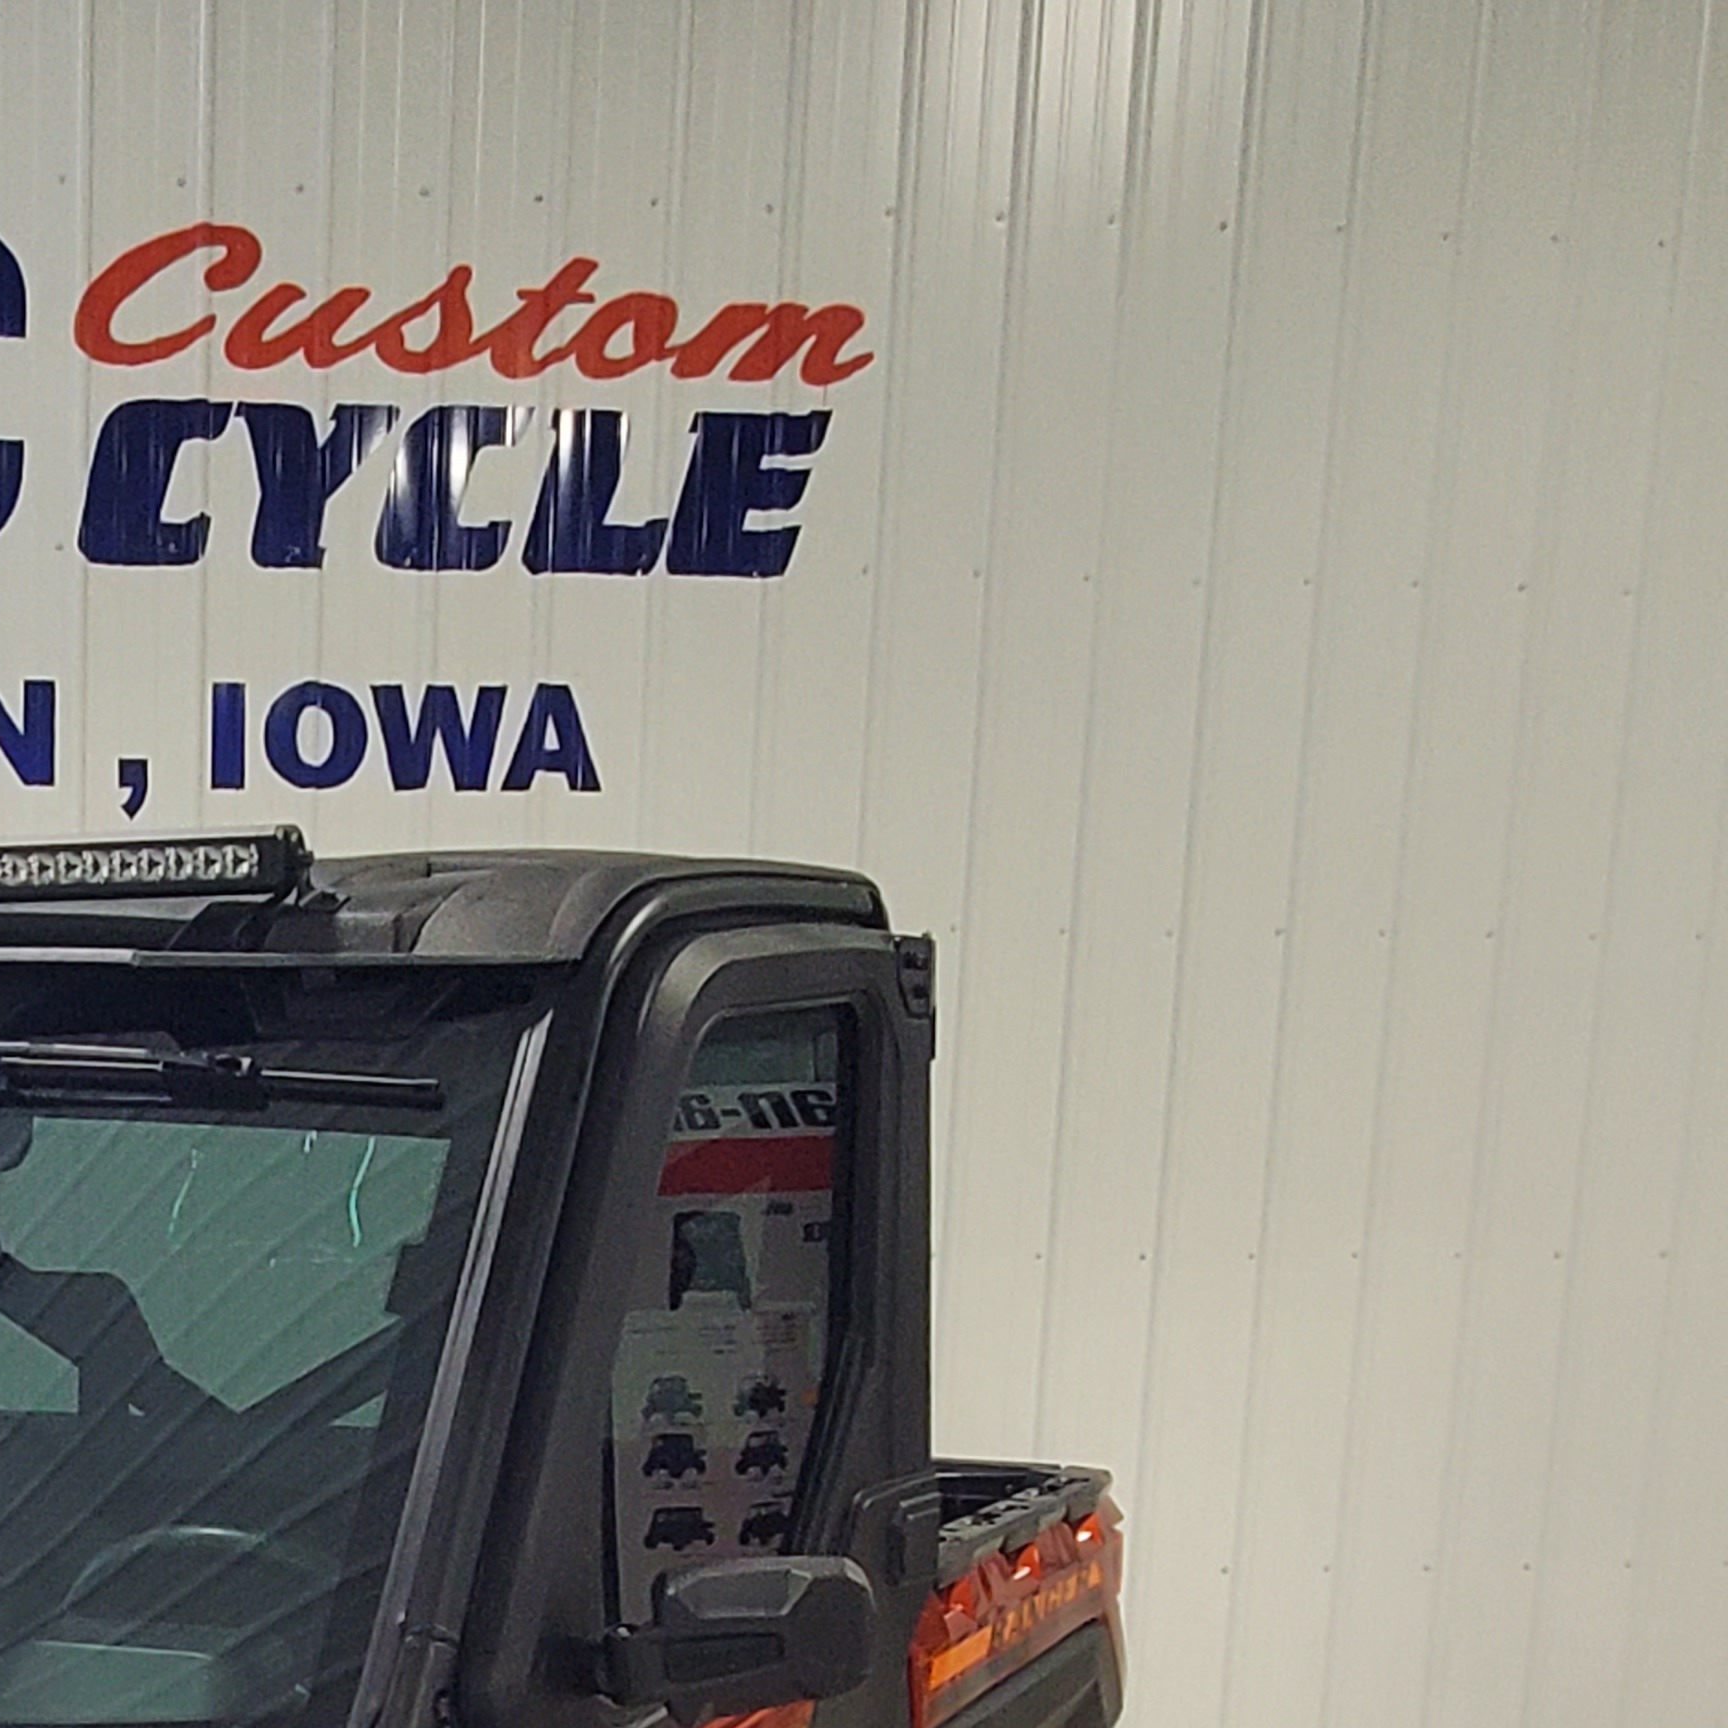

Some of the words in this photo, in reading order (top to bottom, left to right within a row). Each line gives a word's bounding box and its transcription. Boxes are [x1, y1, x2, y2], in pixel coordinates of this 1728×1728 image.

[74, 222, 874, 385] Custom
[78, 398, 833, 578] CYCLE
[211, 680, 601, 792] IOWA
